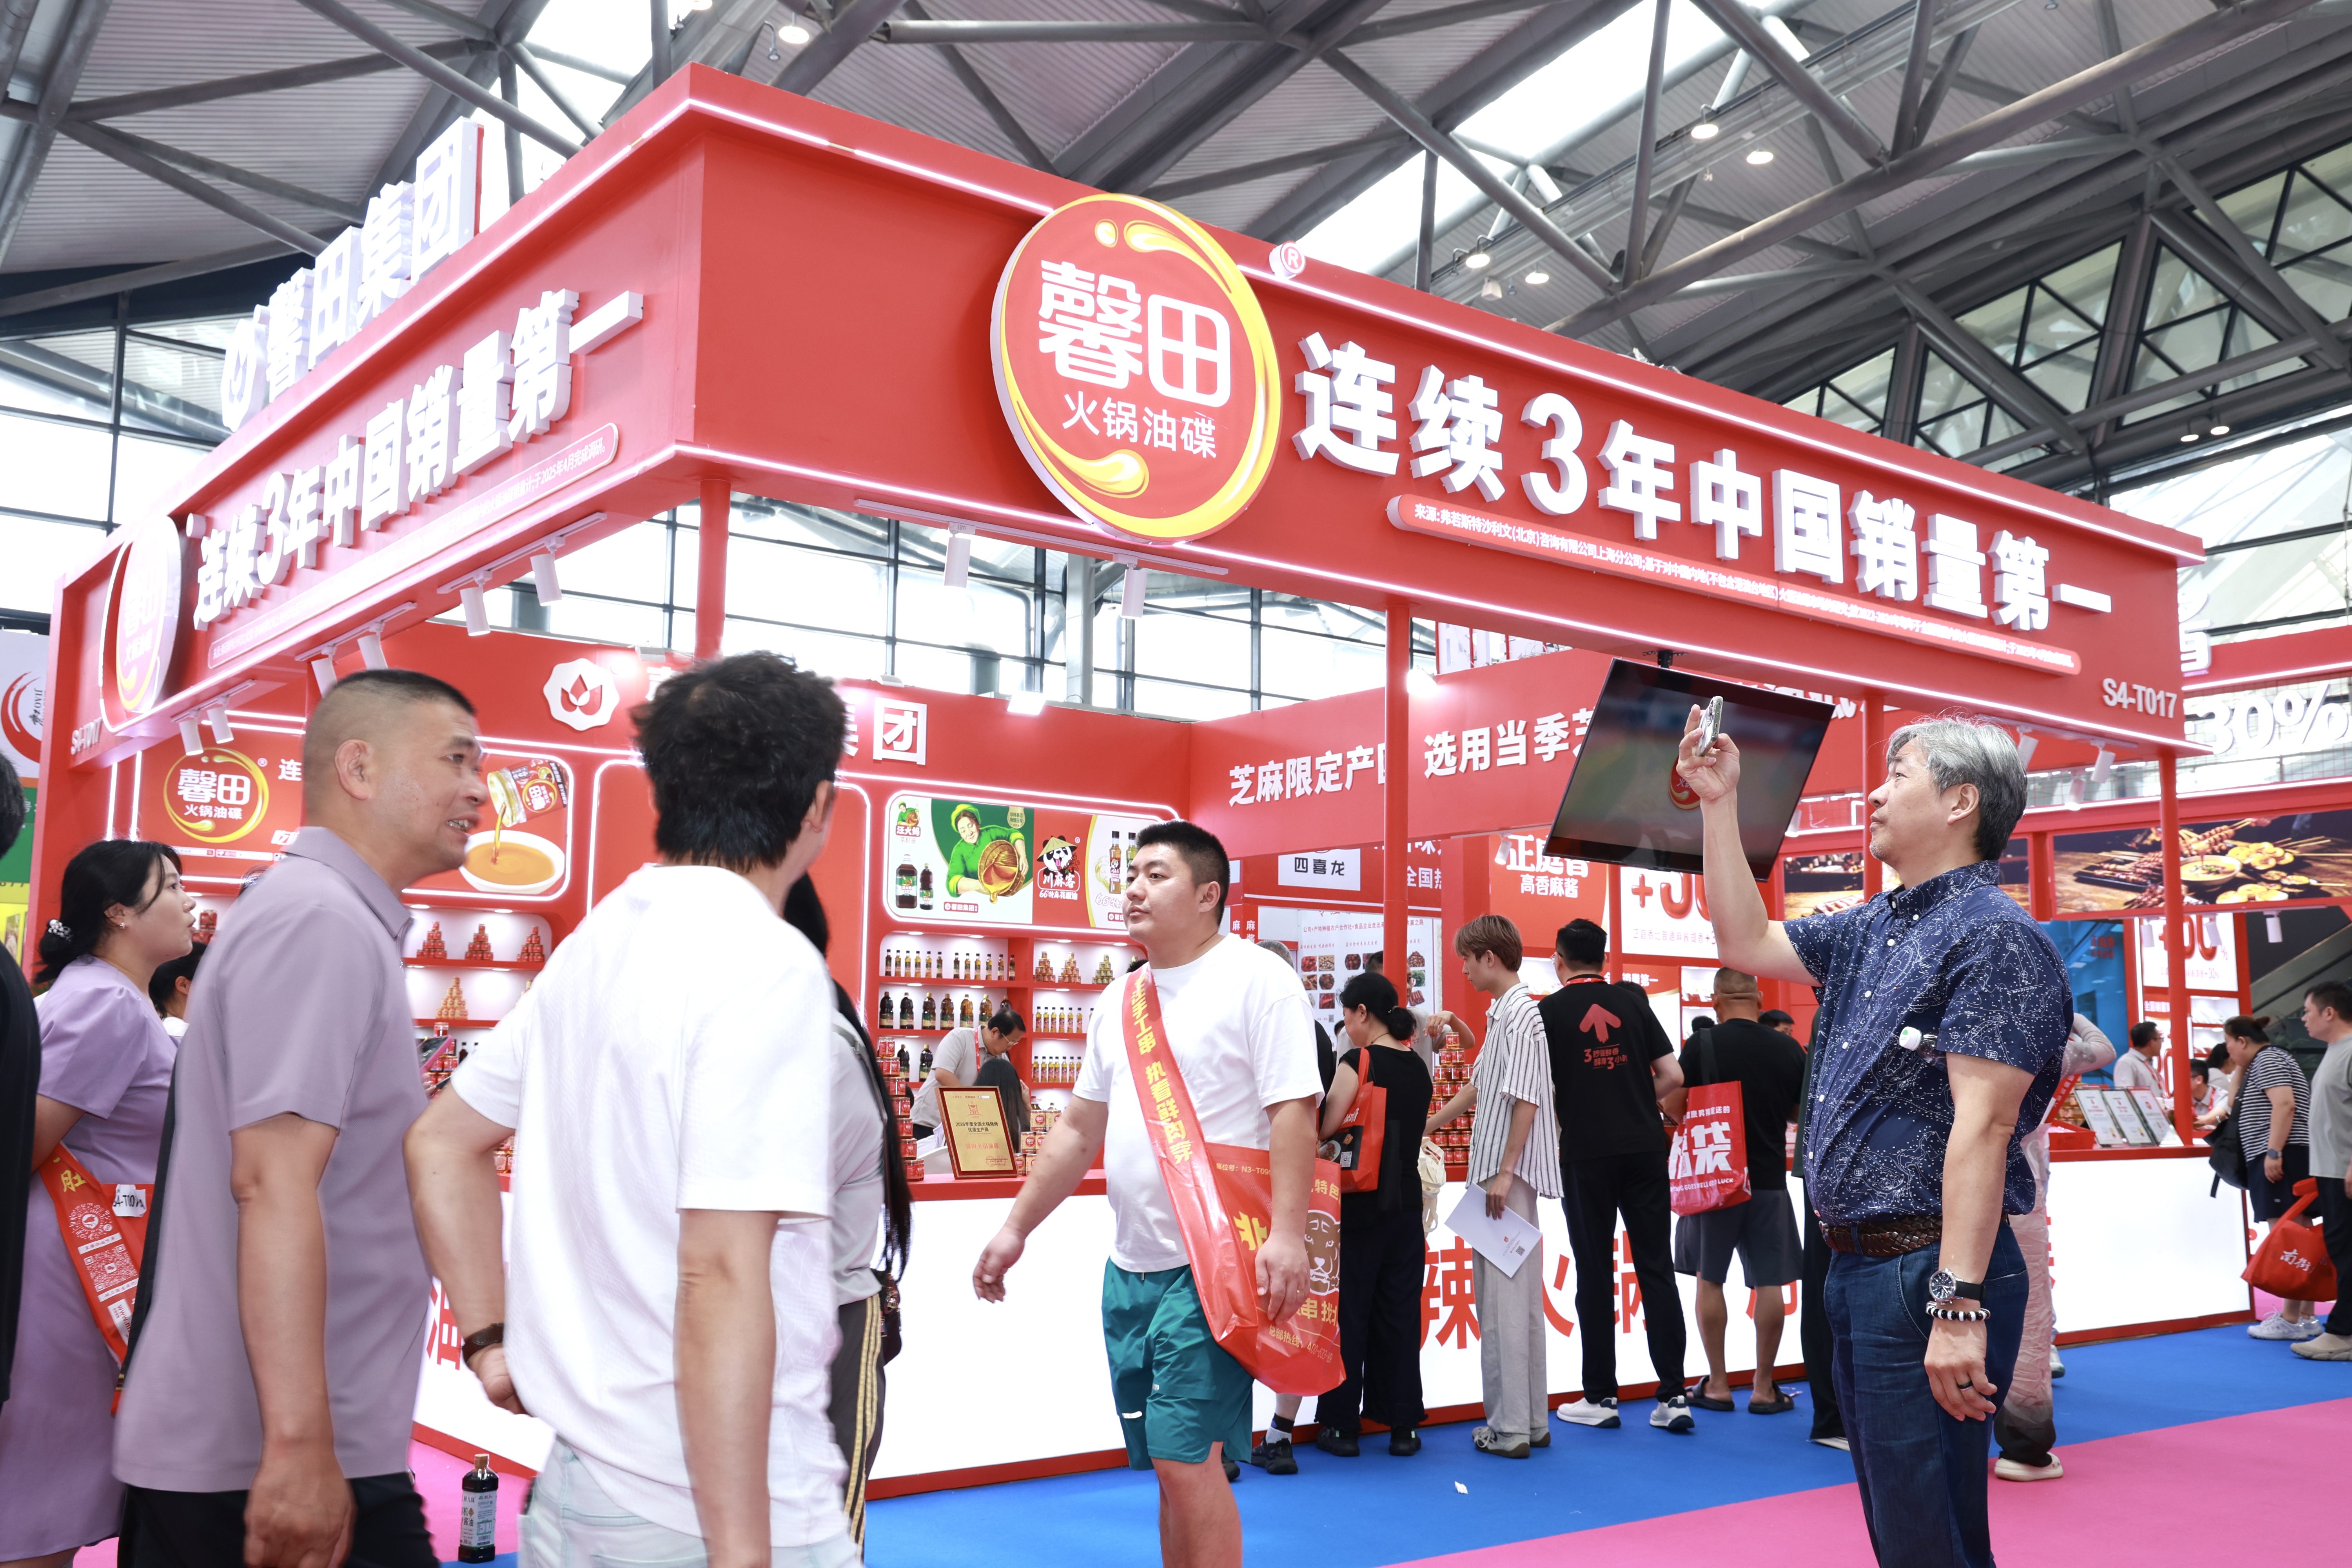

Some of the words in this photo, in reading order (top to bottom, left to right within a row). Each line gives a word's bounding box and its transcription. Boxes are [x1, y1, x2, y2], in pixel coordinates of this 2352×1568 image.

[1037, 259, 1232, 408] 馨田
[1062, 390, 1217, 459] 火锅油碟
[194, 288, 644, 631] 连续3年中国销量第一
[1292, 330, 2112, 631] 连续3年中国销量第一
[2102, 678, 2177, 718] S4-T017
[177, 768, 251, 805] 馨田
[184, 804, 243, 820] 火锅油碟
[896, 826, 920, 836] 汪大妈
[1043, 871, 1076, 889] 川麻客
[1294, 857, 1345, 877] 四喜龙
[1520, 873, 1579, 898] 高香麻酱
